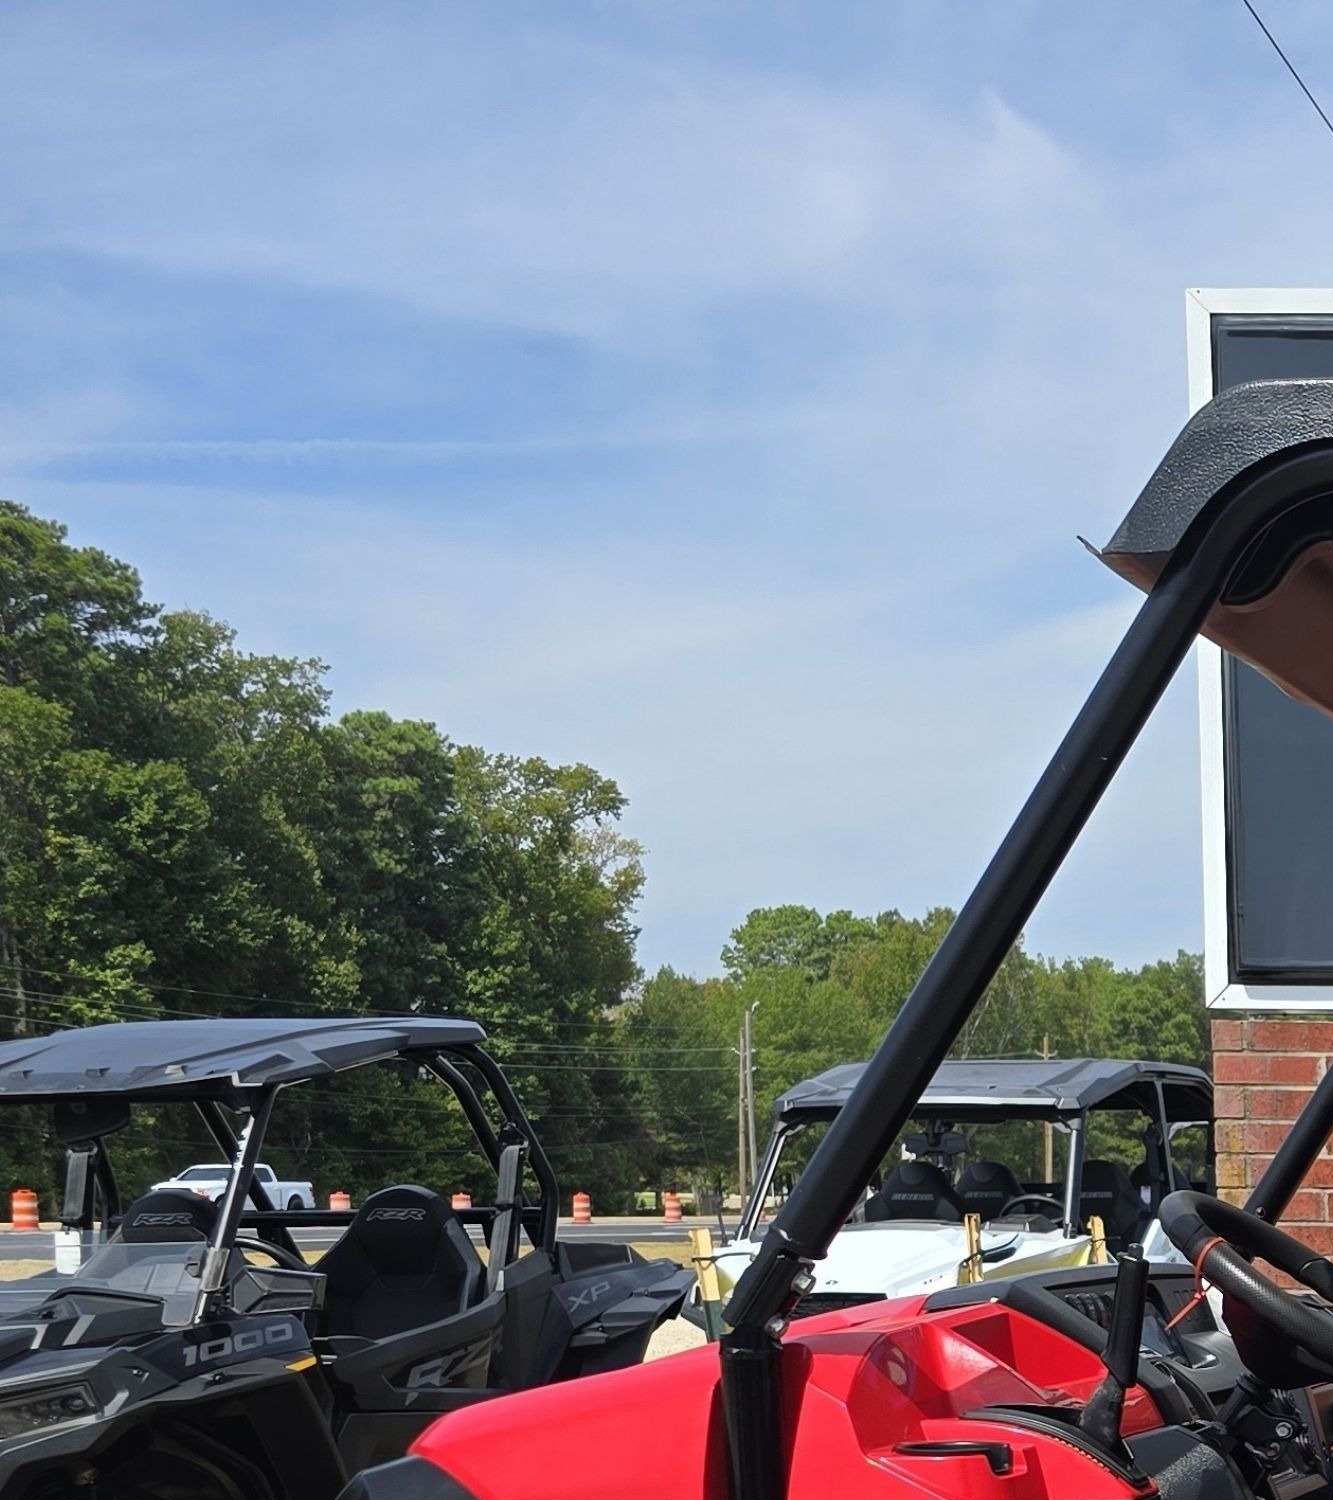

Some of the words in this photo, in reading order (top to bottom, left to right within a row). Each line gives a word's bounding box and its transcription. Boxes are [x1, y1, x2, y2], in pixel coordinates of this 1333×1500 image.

[132, 1212, 194, 1226] RZR
[366, 1207, 427, 1221] RZR
[568, 1281, 611, 1313] XP
[182, 1322, 293, 1366] 1000
